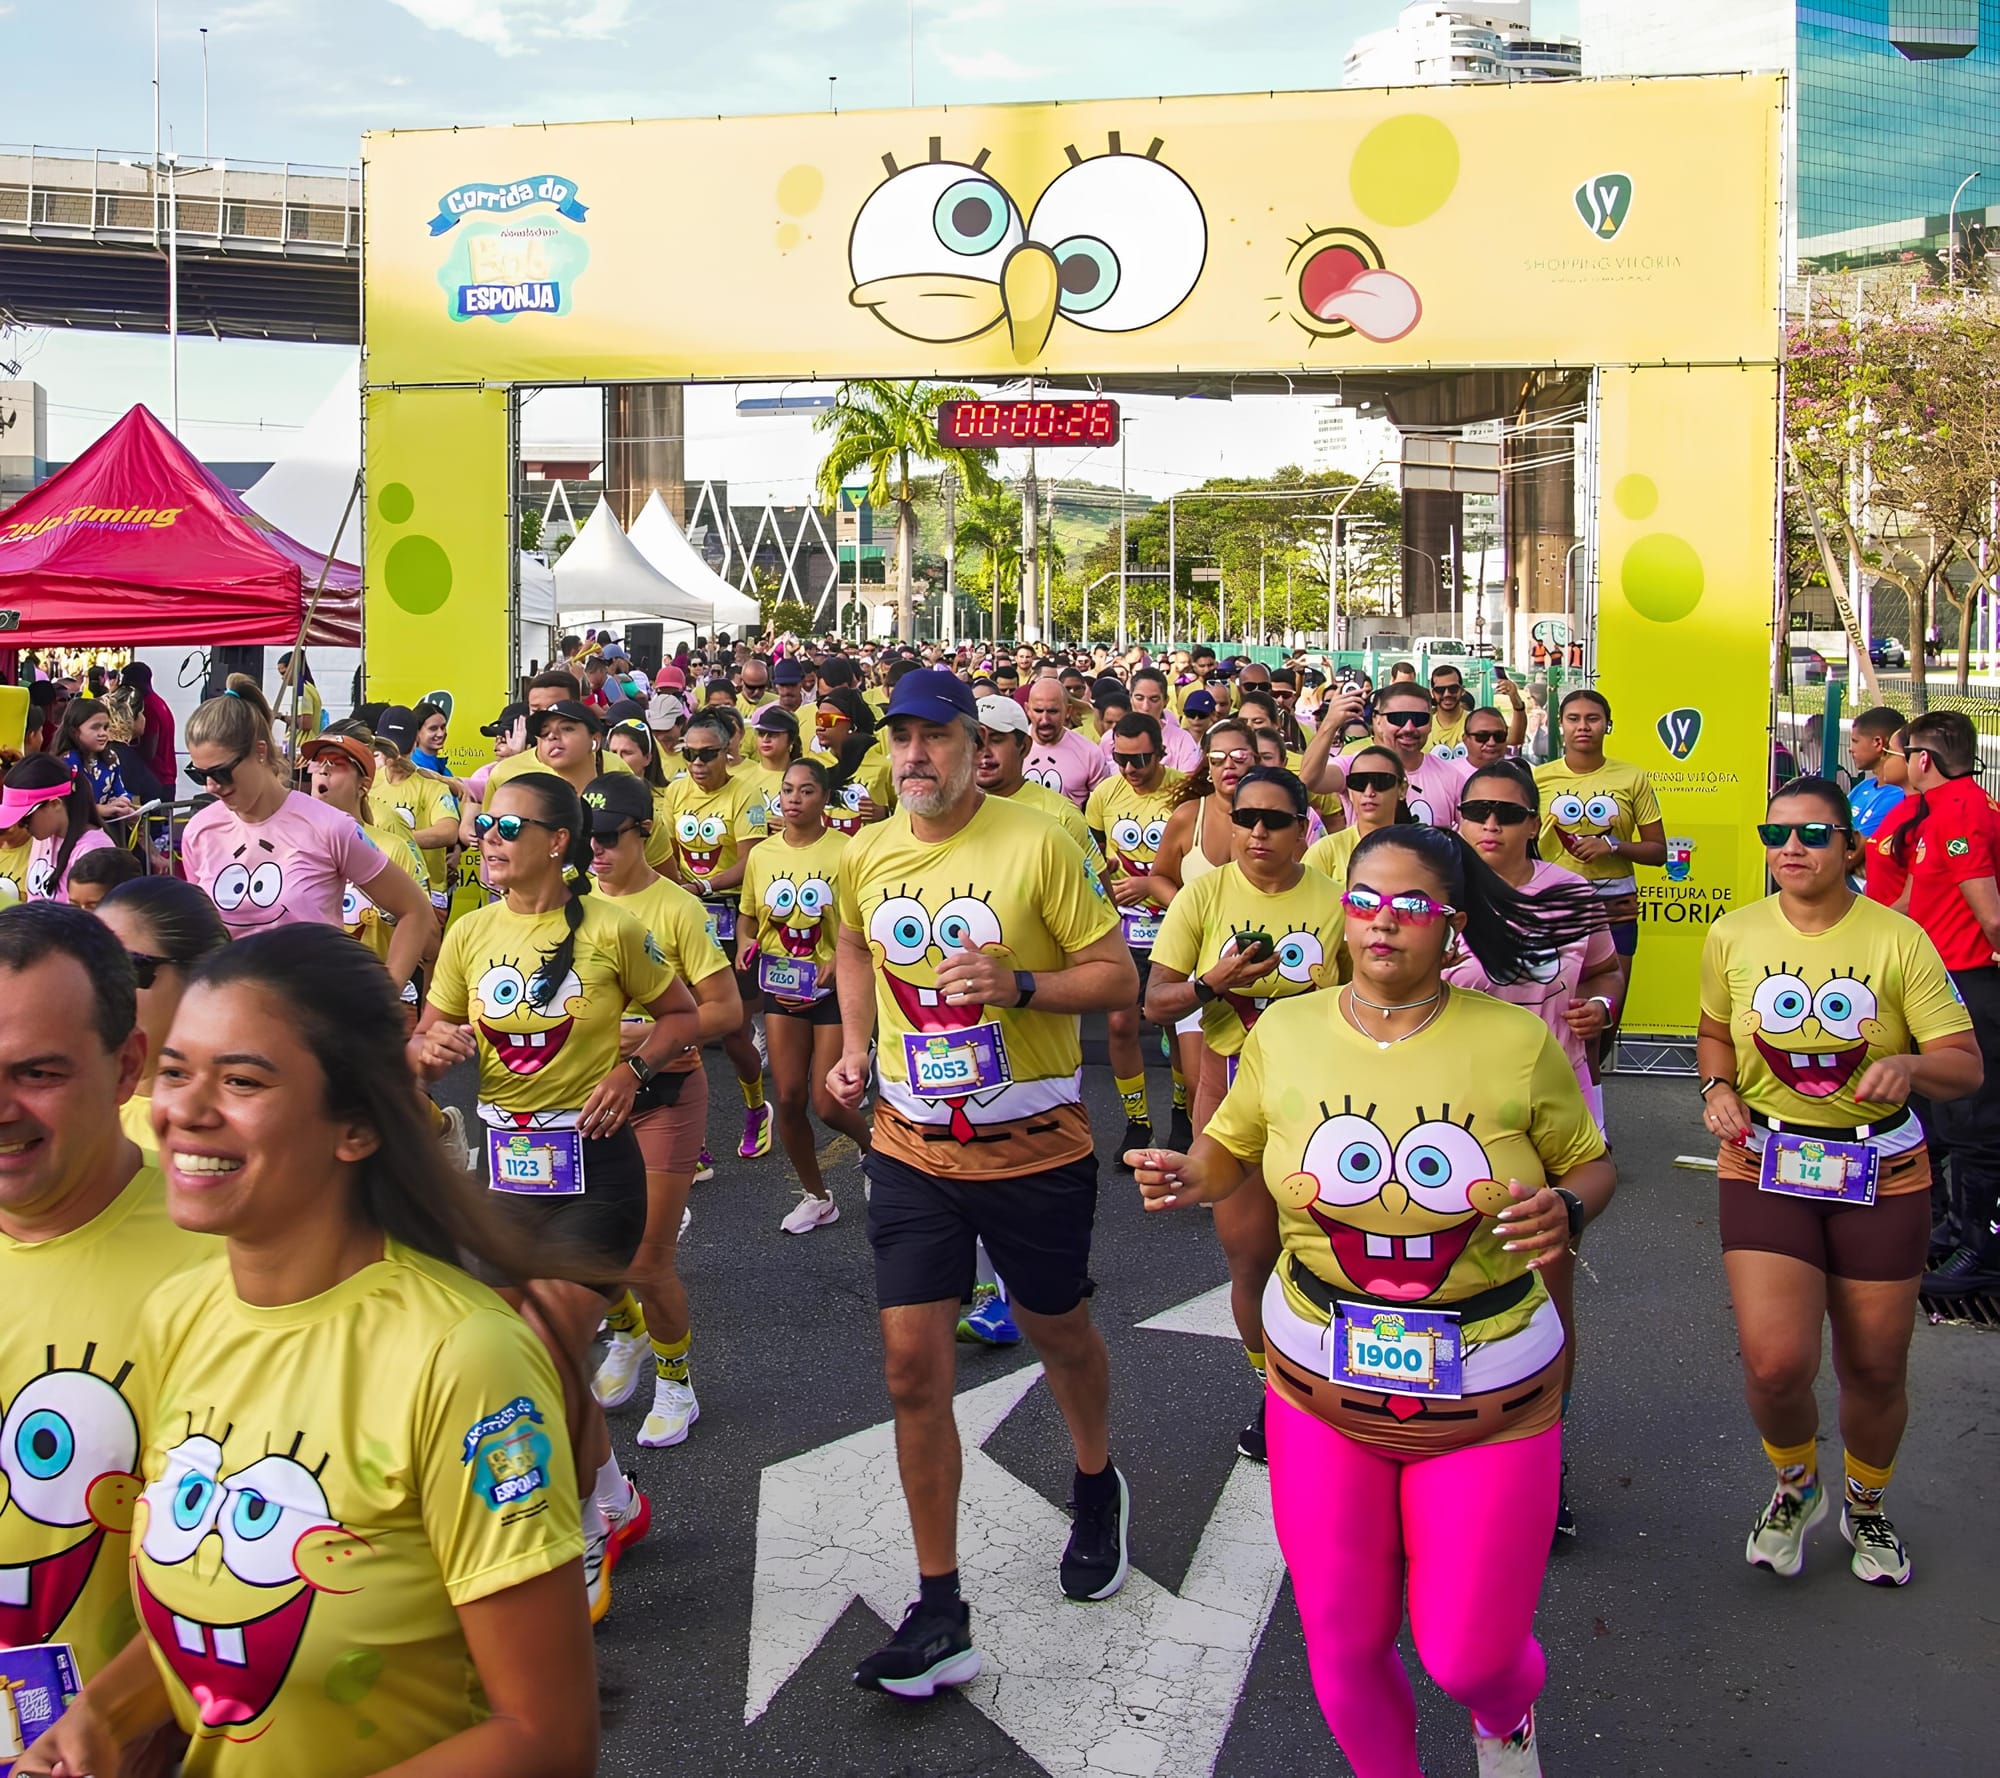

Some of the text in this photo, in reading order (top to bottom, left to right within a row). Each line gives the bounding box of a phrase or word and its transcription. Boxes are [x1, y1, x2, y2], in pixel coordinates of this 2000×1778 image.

[447, 177, 568, 214] Corrida do
[466, 284, 555, 312] ESPONJA
[955, 403, 1109, 437] 00:00:26
[64, 505, 183, 528] Timing
[1637, 886, 1732, 900] EFEITURA DE
[921, 1060, 969, 1080] 2053
[506, 1158, 540, 1177] 1123
[1799, 1163, 1822, 1181] 14
[1356, 1342, 1423, 1372] 1900
